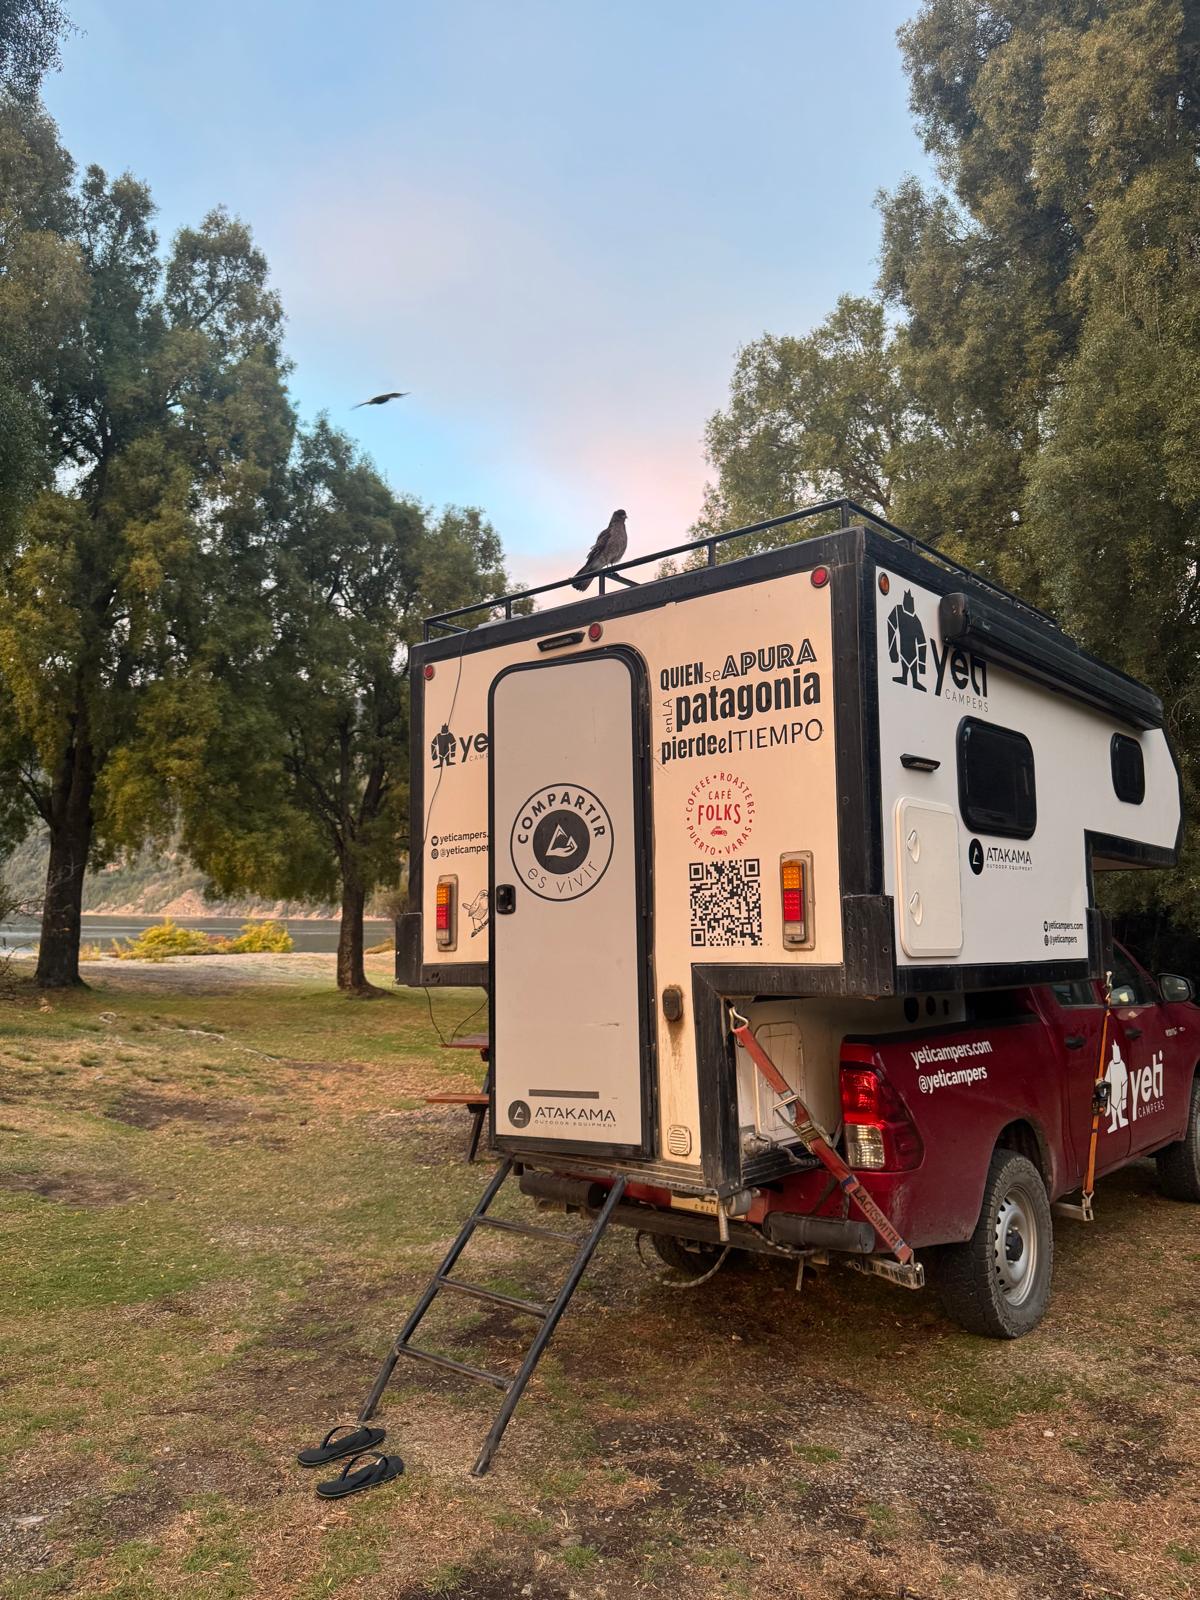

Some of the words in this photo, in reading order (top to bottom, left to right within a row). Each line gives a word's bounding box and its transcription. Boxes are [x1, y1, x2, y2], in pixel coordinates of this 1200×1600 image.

[660, 662, 703, 691] QUIEN
[721, 638, 817, 679] APURA
[676, 668, 821, 732] patagonia
[945, 689, 989, 713] CAMPERS
[733, 718, 823, 751] TIEMPO
[686, 776, 710, 813] COFFEE
[720, 772, 755, 815] ROASTERS
[518, 792, 605, 844] COMPARTIR
[698, 804, 741, 825] FOLKS
[687, 825, 716, 855] PUERTO
[725, 826, 752, 854] VARAS
[986, 847, 1032, 865] ATAKAMA
[528, 868, 547, 889] es
[556, 861, 597, 894] vivir
[910, 1040, 992, 1070] yeticampers.com
[918, 1066, 988, 1094] @yeticampers
[1130, 1050, 1163, 1121] yeti
[535, 1106, 616, 1122] ATAKAMA
[1138, 1100, 1165, 1118] CAMPERS
